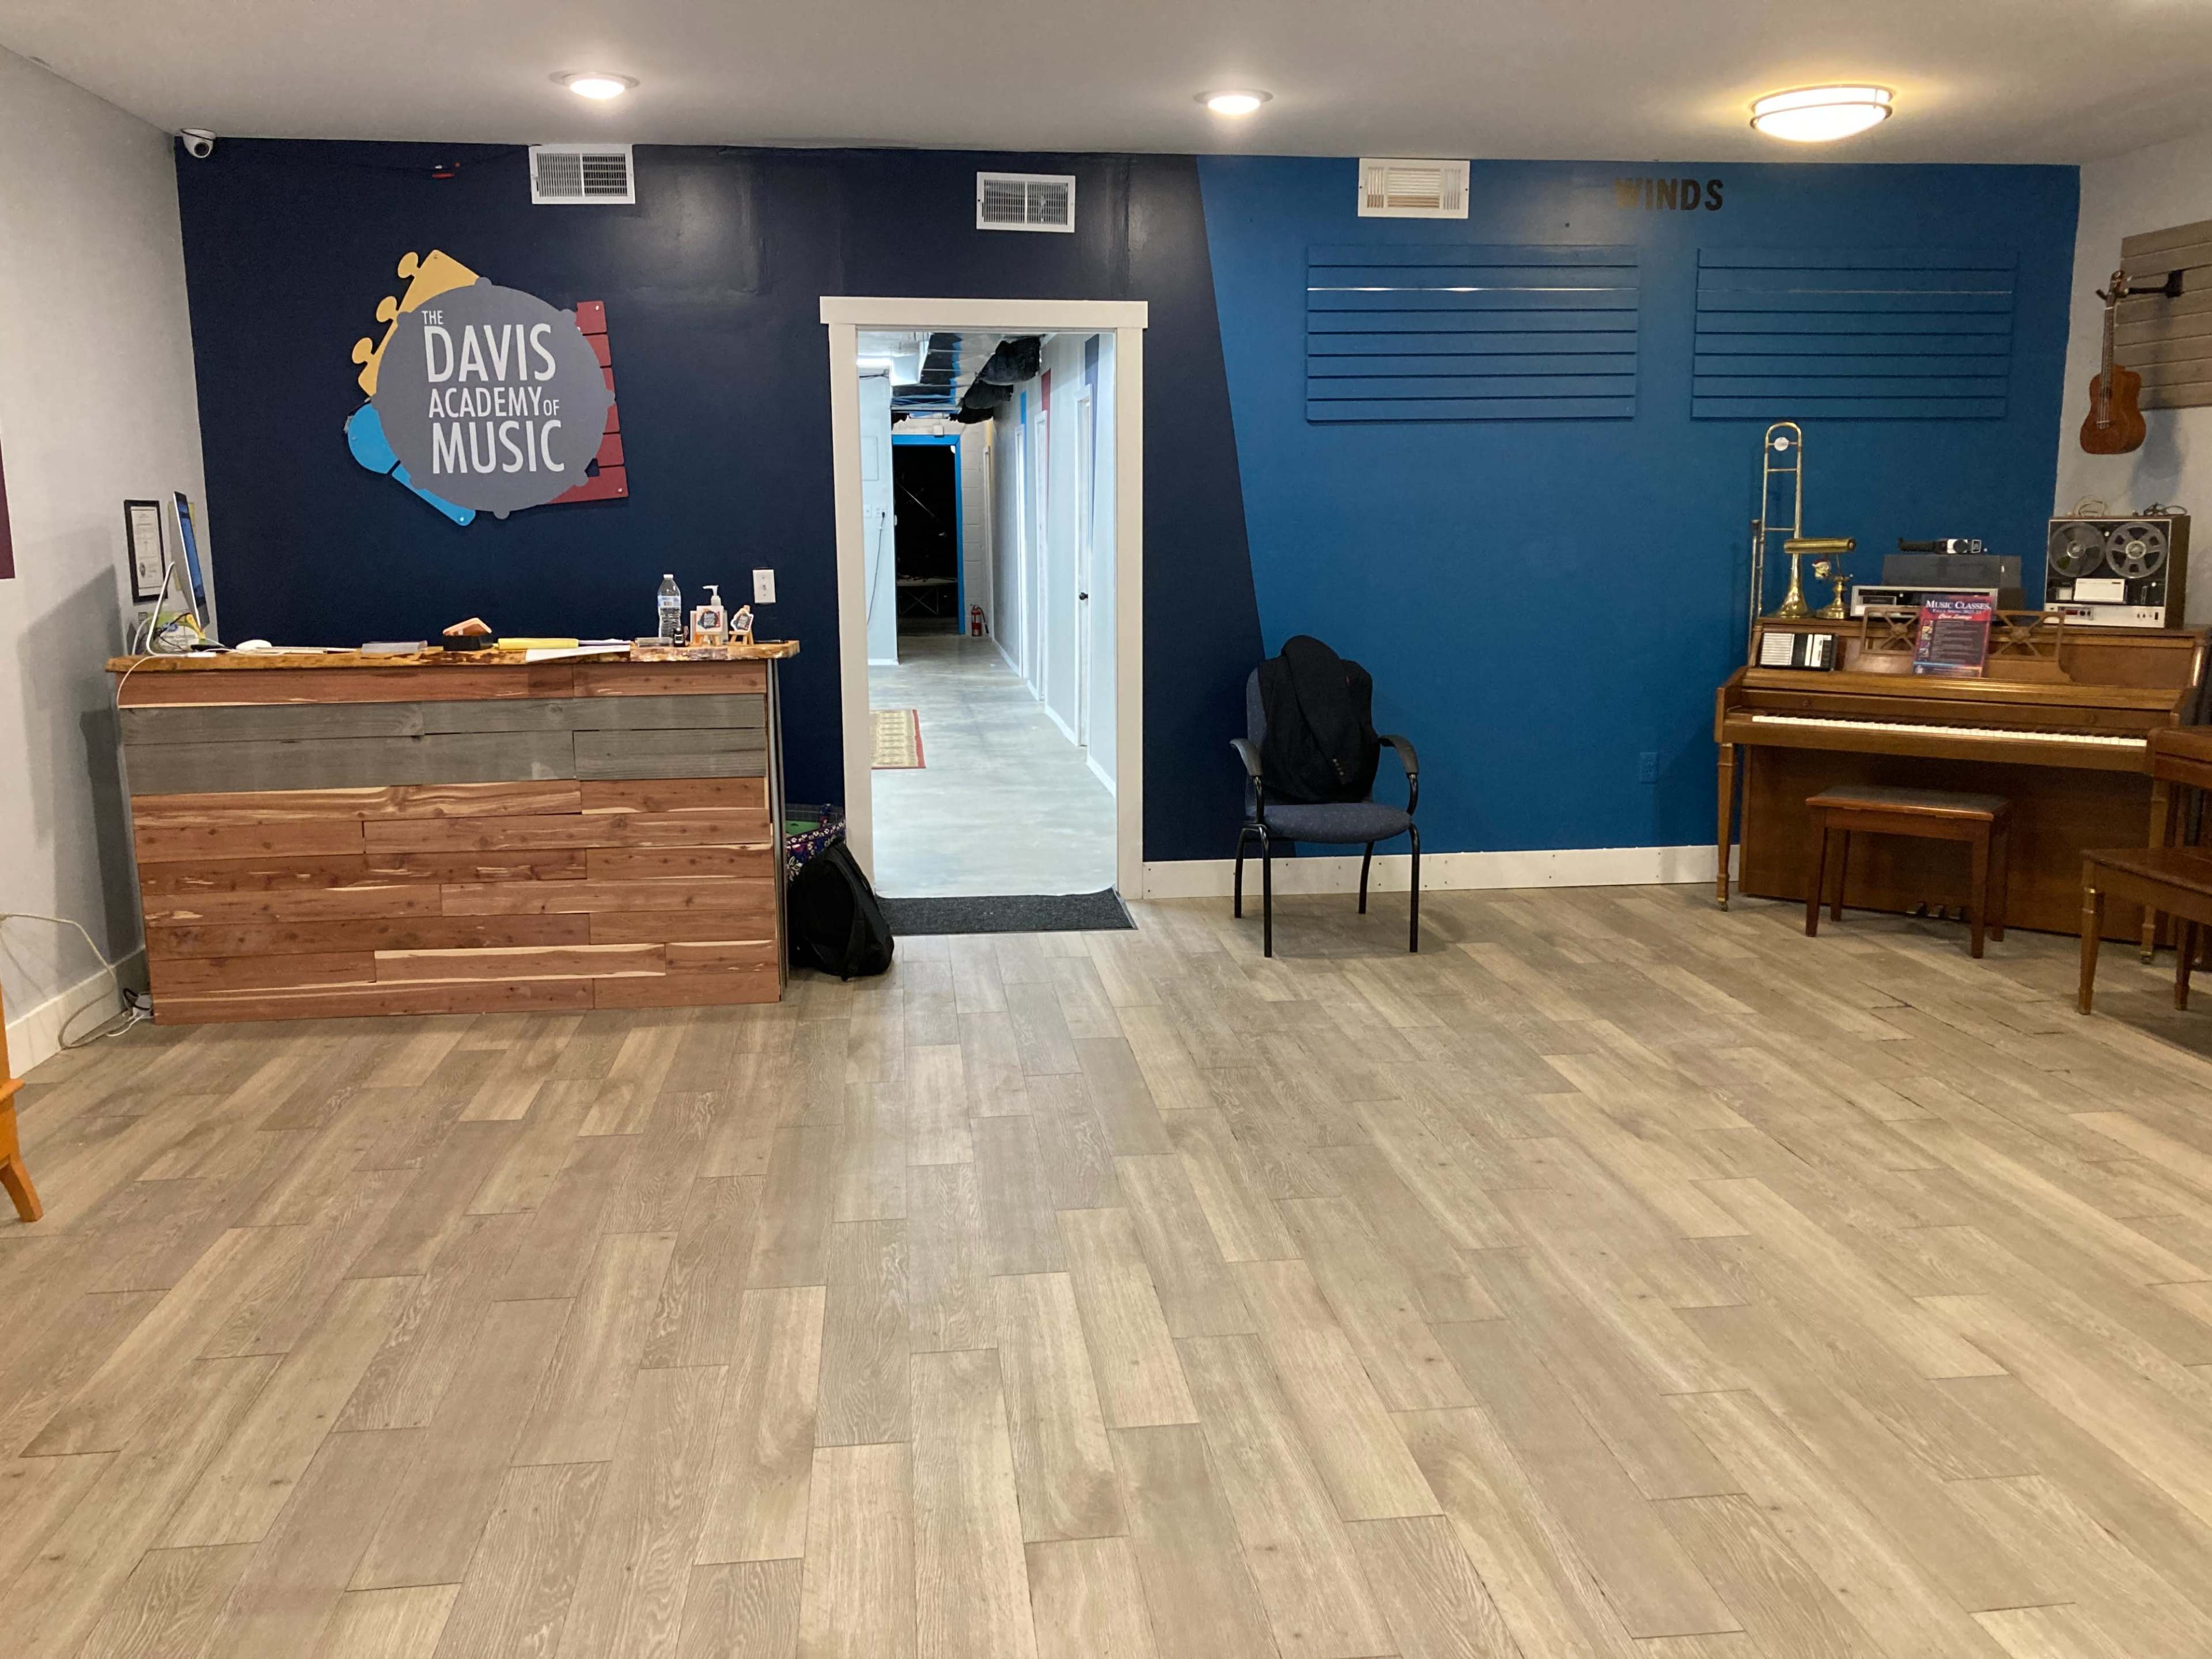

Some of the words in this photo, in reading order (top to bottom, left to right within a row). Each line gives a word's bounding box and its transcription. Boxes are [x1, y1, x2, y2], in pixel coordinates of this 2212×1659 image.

[1614, 176, 1724, 211] WINDS
[422, 310, 443, 325] THE
[424, 323, 556, 382] DAVIS
[429, 386, 541, 418] ACADEMY
[543, 399, 560, 416] OF
[432, 419, 565, 474] MUSIC
[1926, 600, 1953, 608] MUSIC
